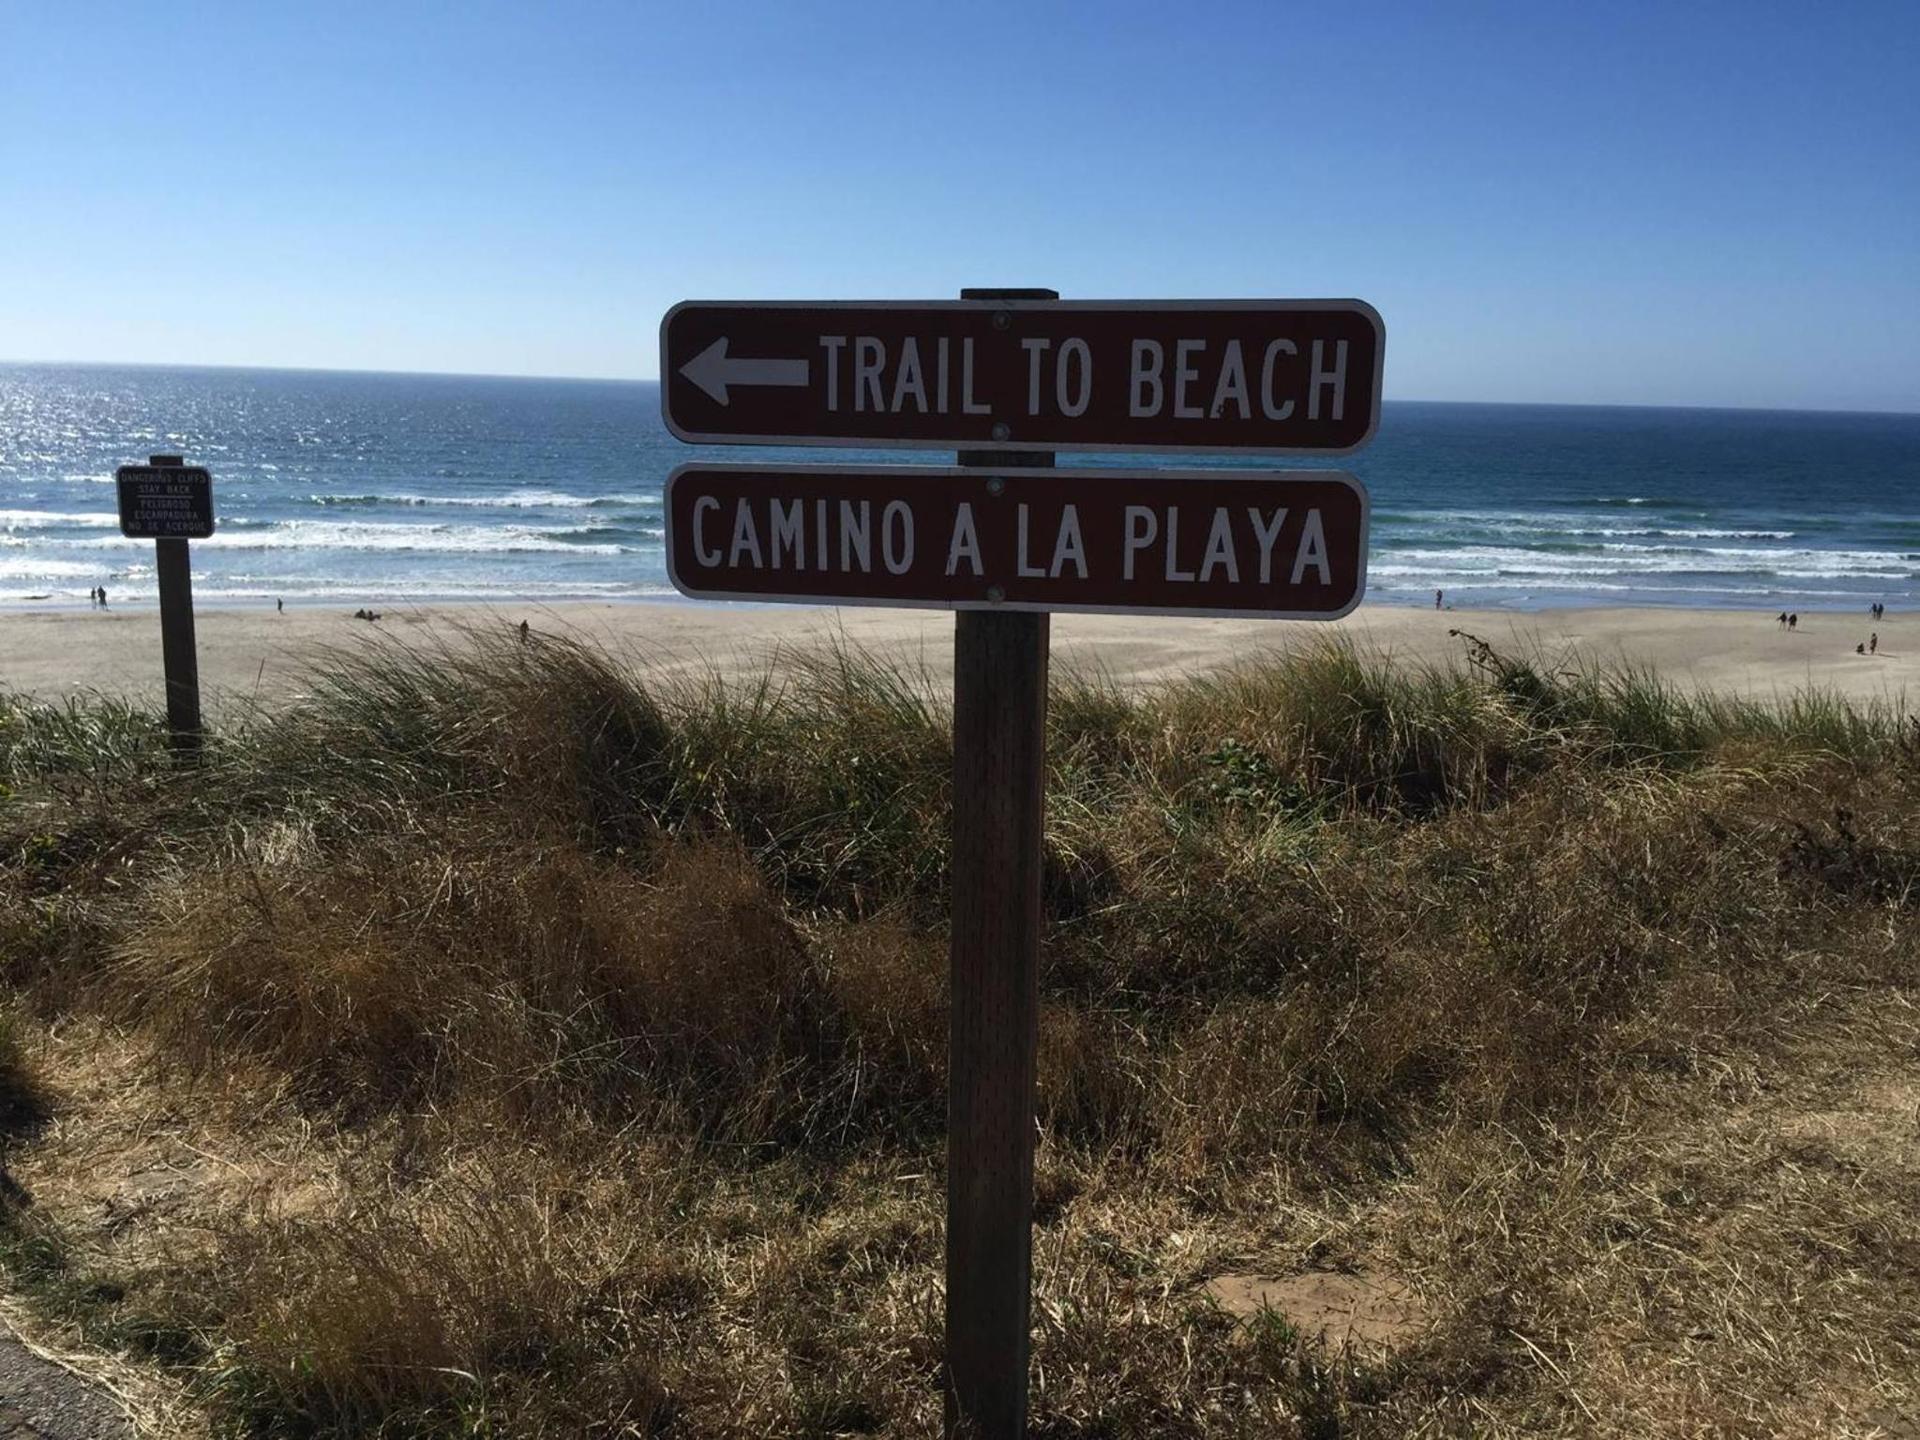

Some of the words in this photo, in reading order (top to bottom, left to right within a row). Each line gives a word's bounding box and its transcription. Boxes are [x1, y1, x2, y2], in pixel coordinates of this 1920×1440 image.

[819, 336, 992, 414] TRAIL
[1021, 338, 1092, 417] TO
[1130, 339, 1349, 420] BEACH
[692, 495, 914, 575] CAMINO
[944, 502, 984, 576] A
[1017, 503, 1089, 579] LA
[1123, 505, 1332, 585] PLAYA
